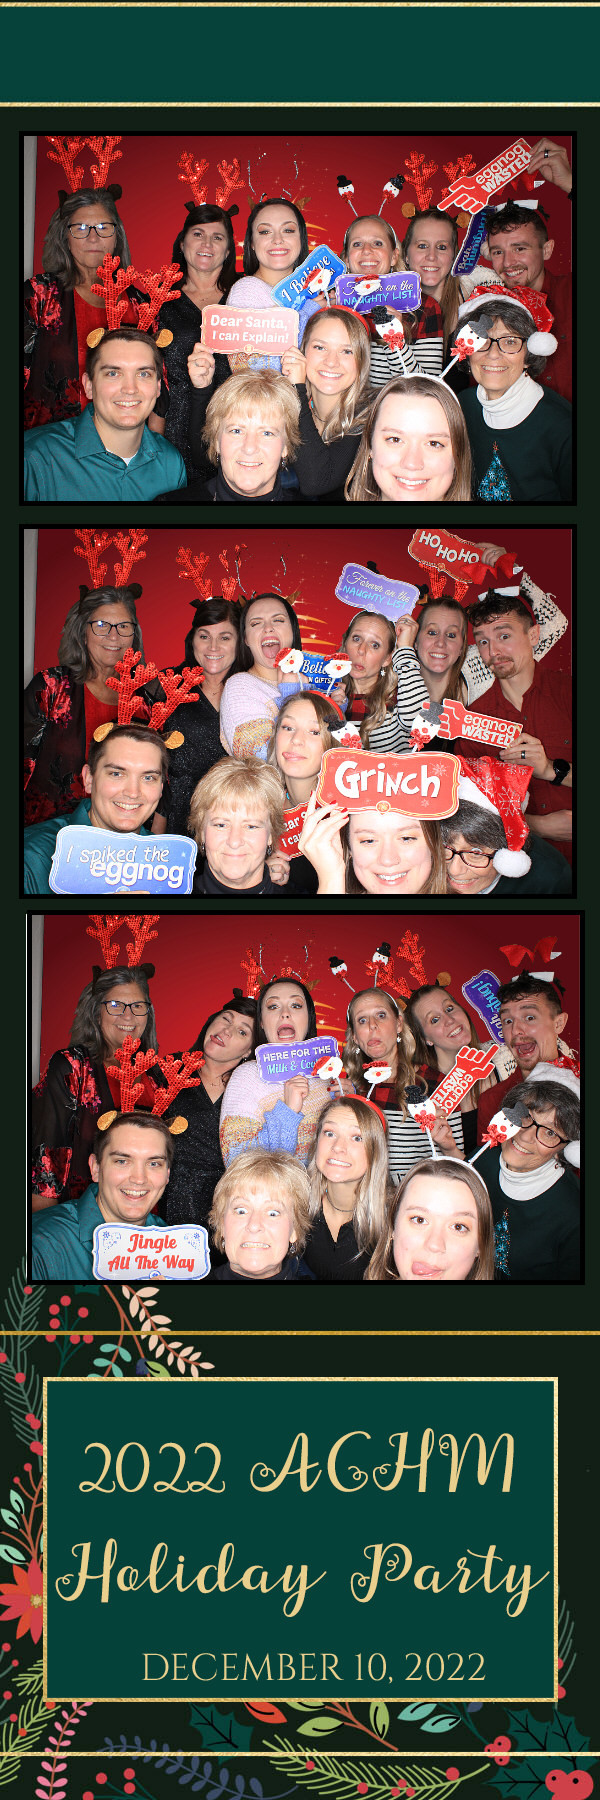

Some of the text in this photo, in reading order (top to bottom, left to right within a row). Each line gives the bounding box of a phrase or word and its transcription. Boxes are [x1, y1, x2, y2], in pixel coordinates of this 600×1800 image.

[476, 144, 526, 185] eggnog
[481, 152, 531, 192] WASTED
[400, 279, 414, 291] the
[343, 290, 413, 306] NAUGHTY LIST
[210, 314, 288, 329] Dear Santa,
[212, 330, 289, 344] I can Explain!
[418, 530, 441, 549] HO
[435, 545, 480, 564] HO HO
[346, 571, 411, 603] Forever on the
[342, 585, 409, 609] NAUGHTY LIST
[464, 714, 517, 735] eggnog
[461, 723, 515, 746] WASTED
[66, 845, 170, 869] I spiked the
[90, 859, 185, 889] eggnog
[263, 1045, 331, 1062] HERE FOR THE
[266, 1061, 288, 1075] Milk
[290, 1060, 298, 1071] &
[127, 1233, 178, 1253] Jingle
[107, 1254, 195, 1272] All The Way
